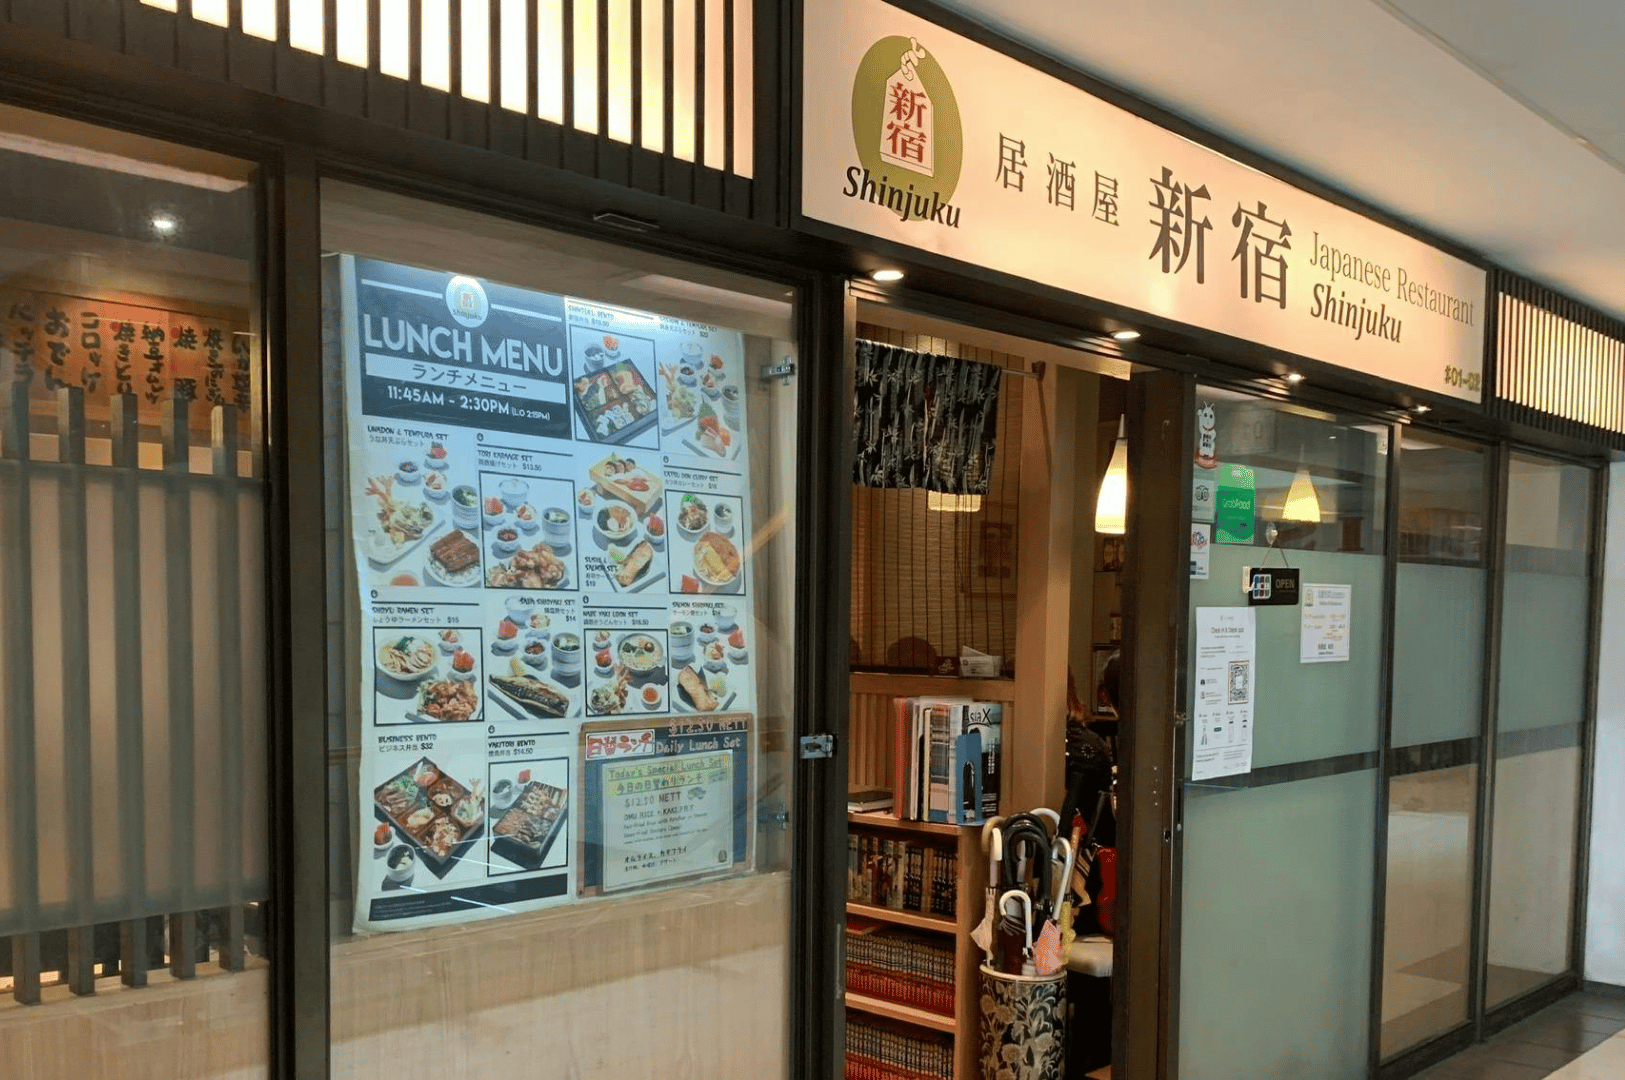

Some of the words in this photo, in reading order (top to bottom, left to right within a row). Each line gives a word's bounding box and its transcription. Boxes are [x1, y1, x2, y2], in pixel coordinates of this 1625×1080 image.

[886, 82, 928, 164] 新宿
[843, 166, 961, 229] Shinjuku
[995, 132, 1120, 227] 居酒屋
[1148, 165, 1292, 310] 新宿
[1309, 231, 1391, 292] Japanese
[1397, 267, 1474, 327] Restaurant
[1310, 283, 1403, 343] Shinjuku
[363, 314, 473, 362] LUNCH
[481, 334, 564, 376] MENU
[412, 363, 528, 392] ランチメニュー
[387, 385, 444, 406] 11:45AM
[460, 395, 509, 414] 2:30PM
[1275, 578, 1295, 589] OPEN
[420, 607, 434, 615] SET
[378, 734, 414, 743] BUSINESS
[416, 733, 438, 742] BENTO
[420, 742, 433, 750] $32
[656, 740, 685, 754] Daily
[689, 738, 718, 752] Lunch
[723, 736, 741, 748] Set
[646, 763, 677, 776] Special
[682, 761, 705, 770] Lunch
[658, 791, 681, 803] NETT
